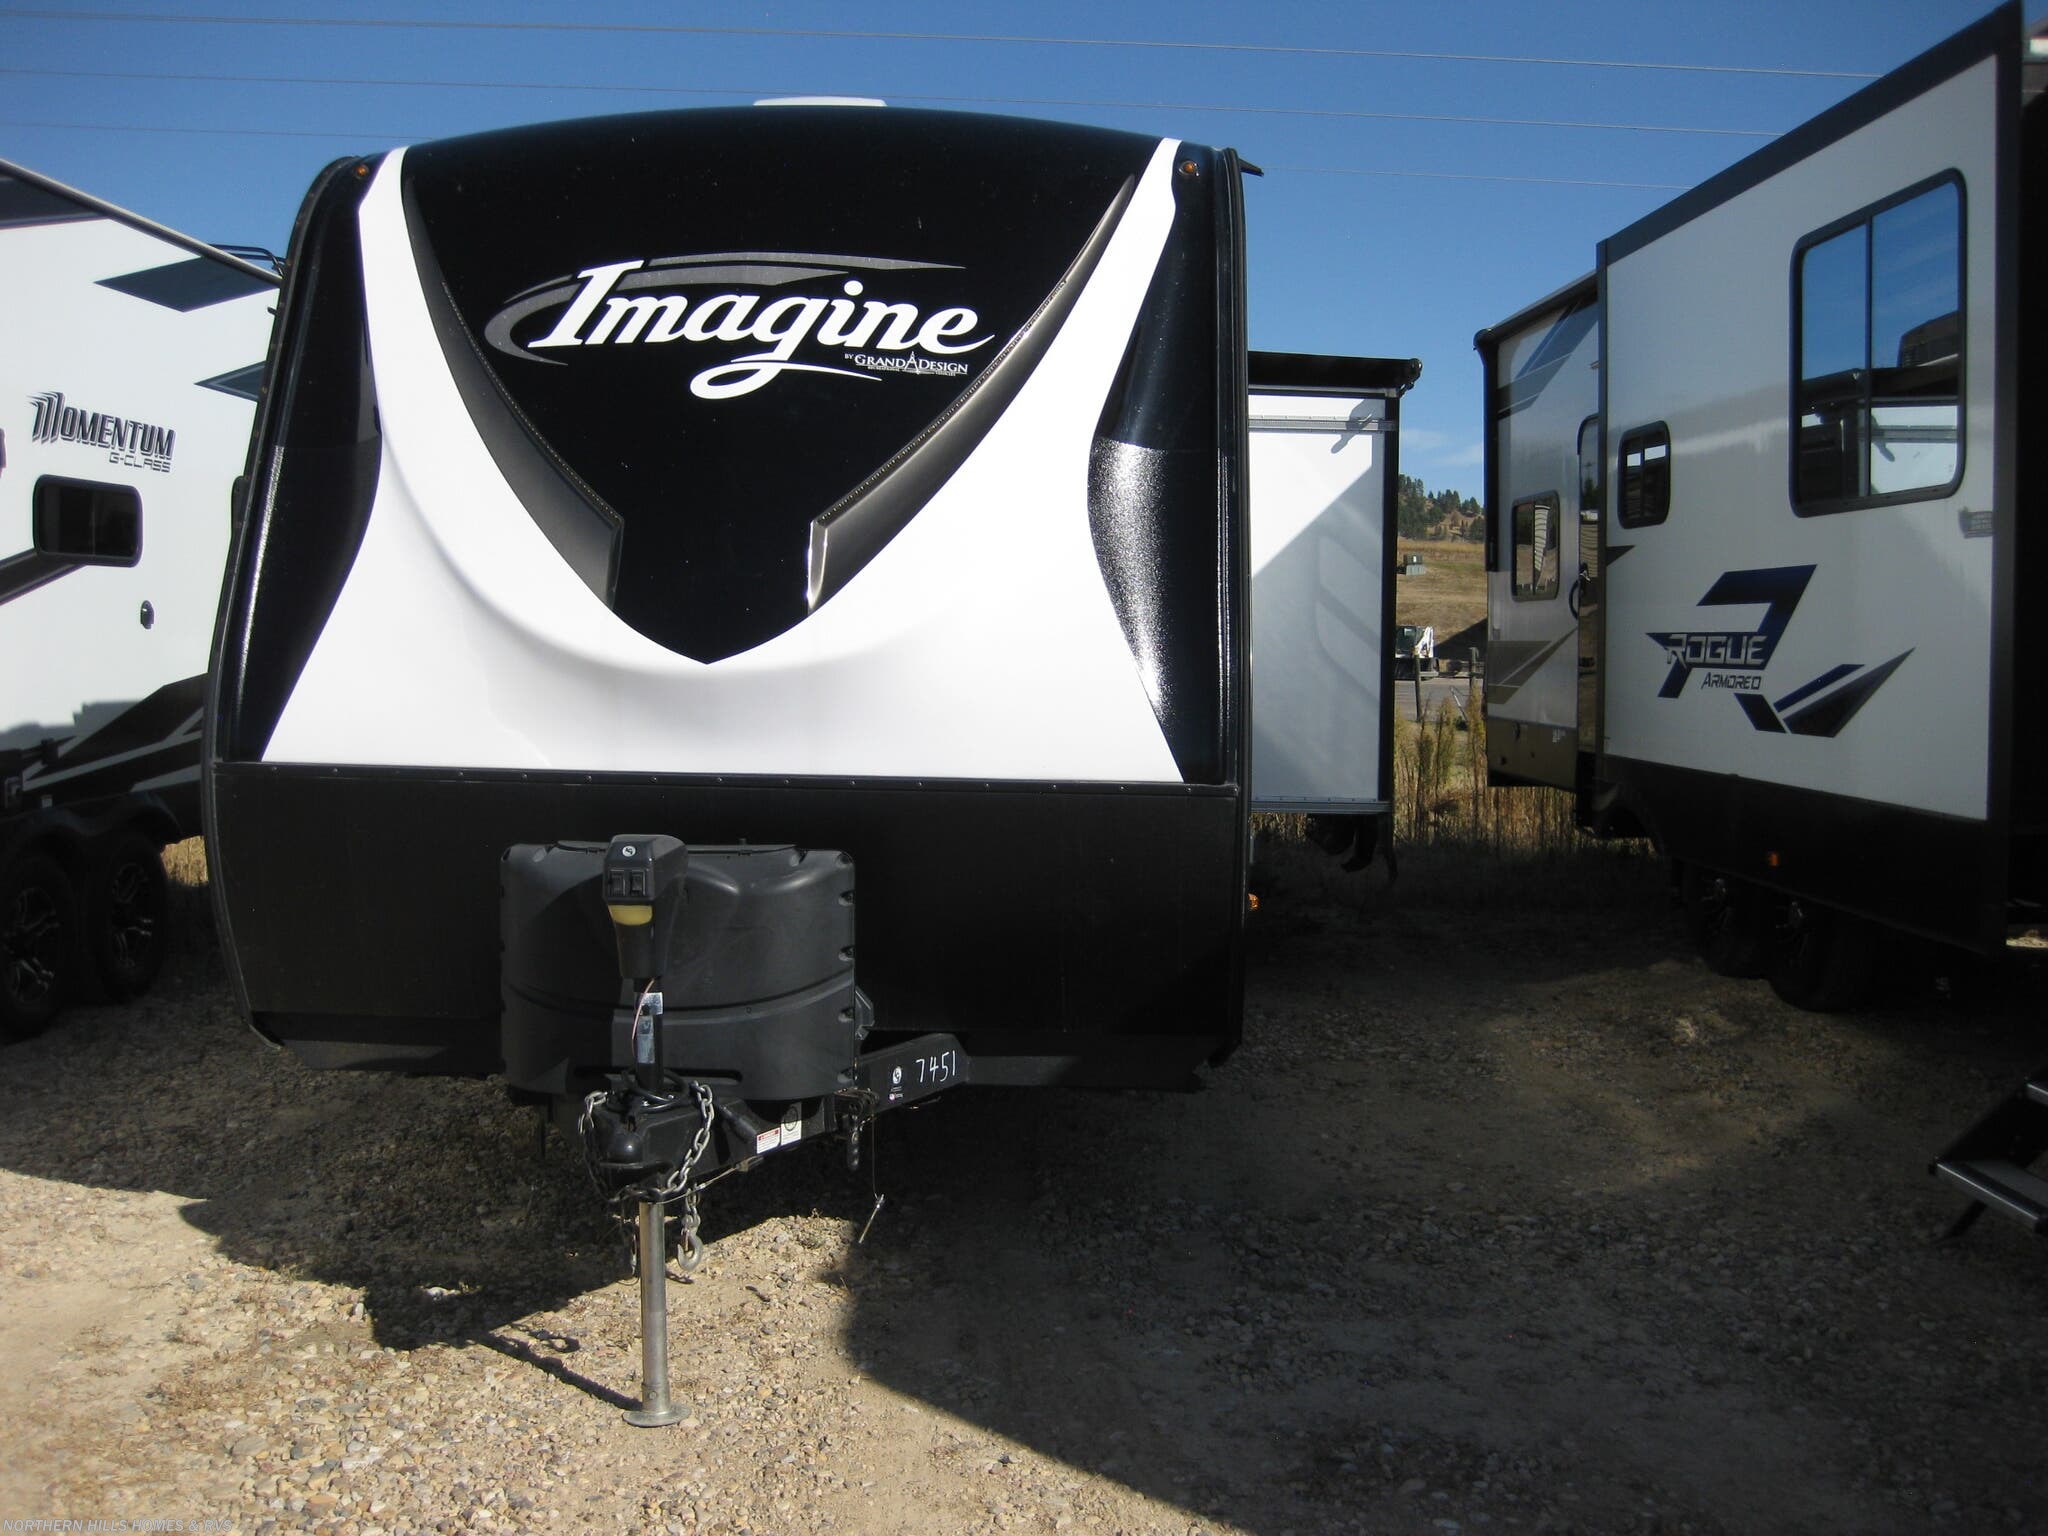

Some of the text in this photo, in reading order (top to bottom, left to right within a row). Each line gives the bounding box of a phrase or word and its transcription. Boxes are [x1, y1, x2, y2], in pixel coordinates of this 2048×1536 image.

[527, 259, 995, 400] Imagine
[26, 391, 177, 461] MOMENTUM
[108, 452, 172, 473] G-CLASS
[1664, 634, 1768, 669] ROGUE
[1701, 672, 1762, 690] ARMORED
[916, 1050, 955, 1083] 7451
